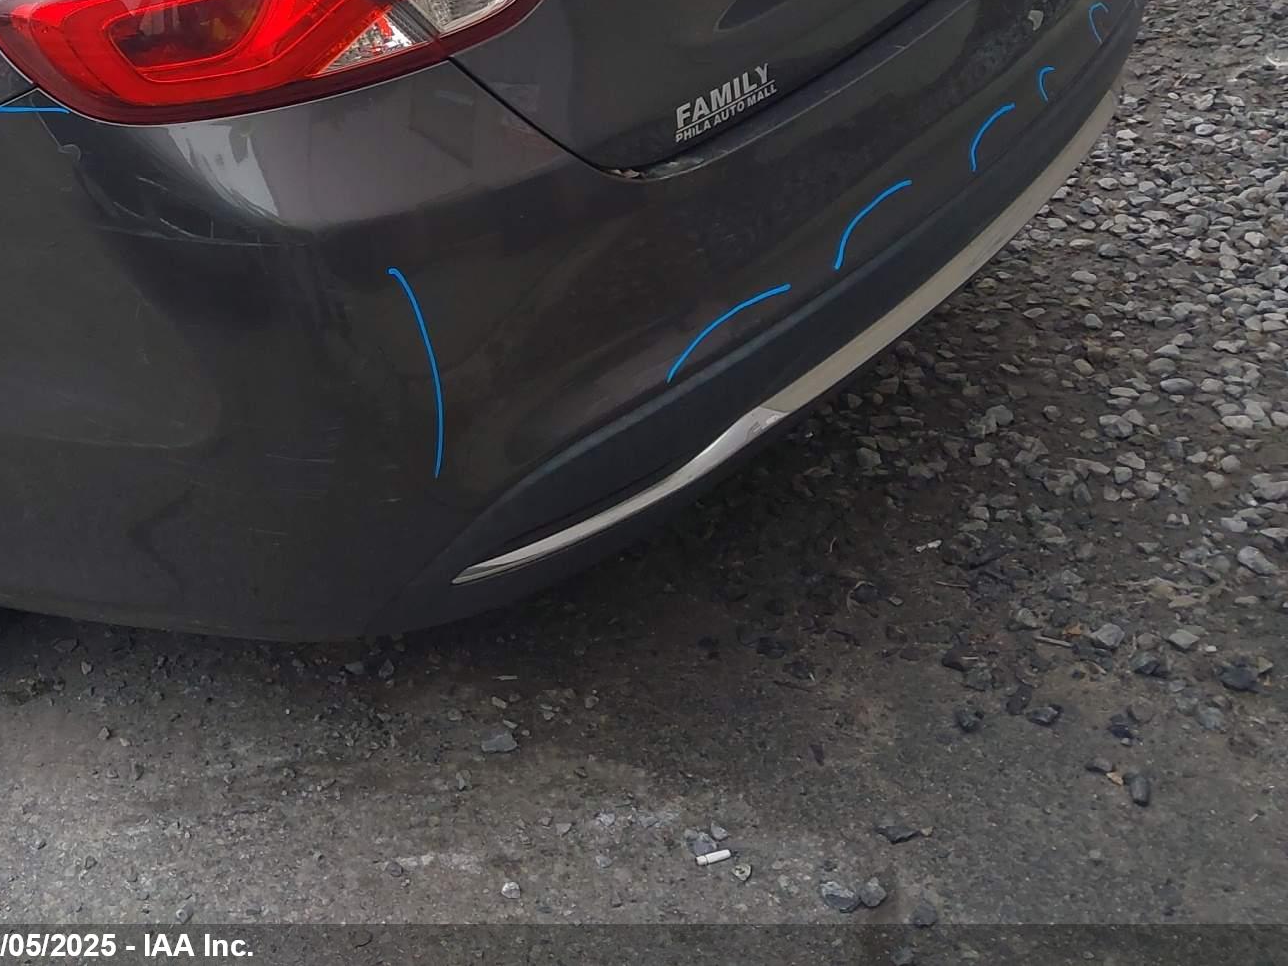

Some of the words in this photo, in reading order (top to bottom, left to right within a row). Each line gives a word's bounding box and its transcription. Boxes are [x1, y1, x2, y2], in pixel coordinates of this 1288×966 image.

[676, 63, 769, 130] FAMILY
[713, 101, 745, 126] AUTO
[747, 84, 778, 107] MALL
